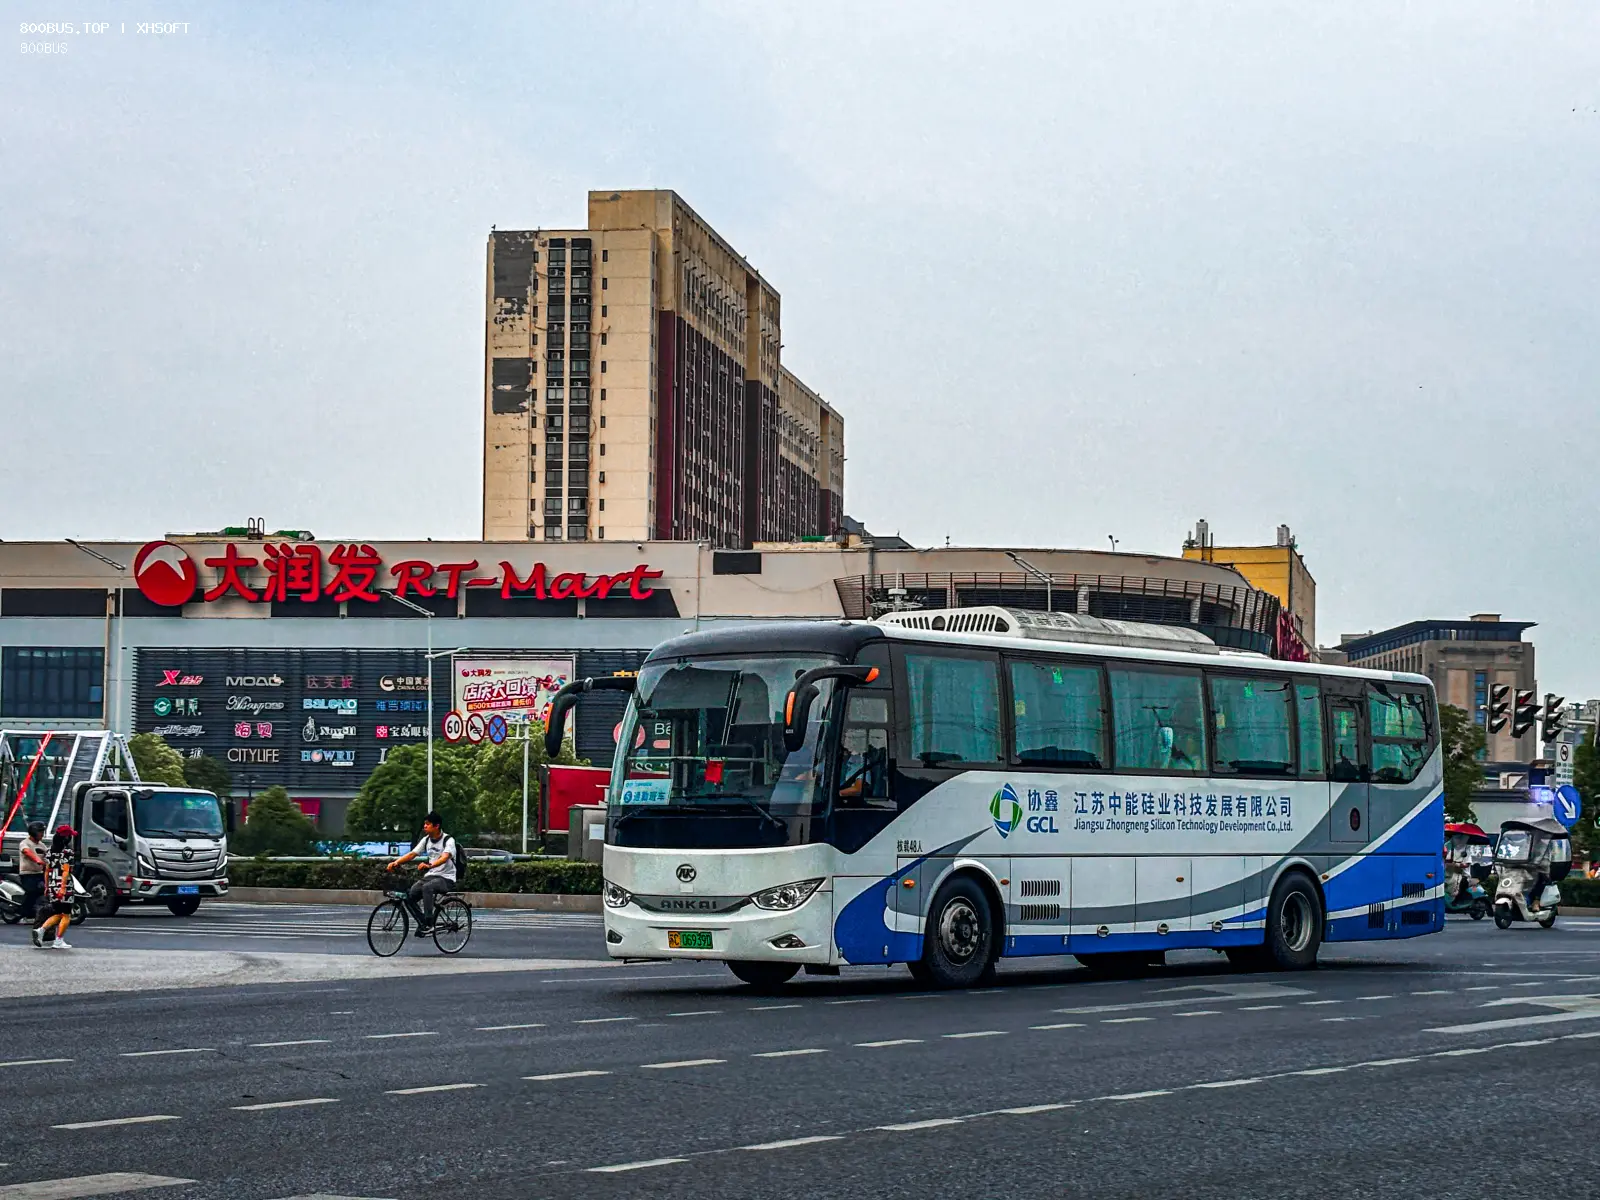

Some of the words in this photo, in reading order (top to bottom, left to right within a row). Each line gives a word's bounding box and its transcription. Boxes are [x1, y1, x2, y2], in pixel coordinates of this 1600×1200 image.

[204, 543, 382, 602] 大润发
[391, 559, 664, 601] RT-Mart
[463, 677, 537, 701] 店庆大回馈
[447, 720, 460, 734] 60
[227, 748, 280, 763] CITYLIFE
[1028, 789, 1058, 812] 协鑫
[1074, 791, 1291, 818] 江苏中能硅业科技发展有限公司
[1027, 816, 1059, 833] GCL
[1074, 818, 1105, 833] Jiangsu
[1106, 818, 1149, 834] Zhongneng
[1150, 819, 1175, 831] Silicon
[1177, 819, 1218, 834] Technology
[1219, 820, 1266, 834] Development
[660, 900, 717, 910] ANKAI
